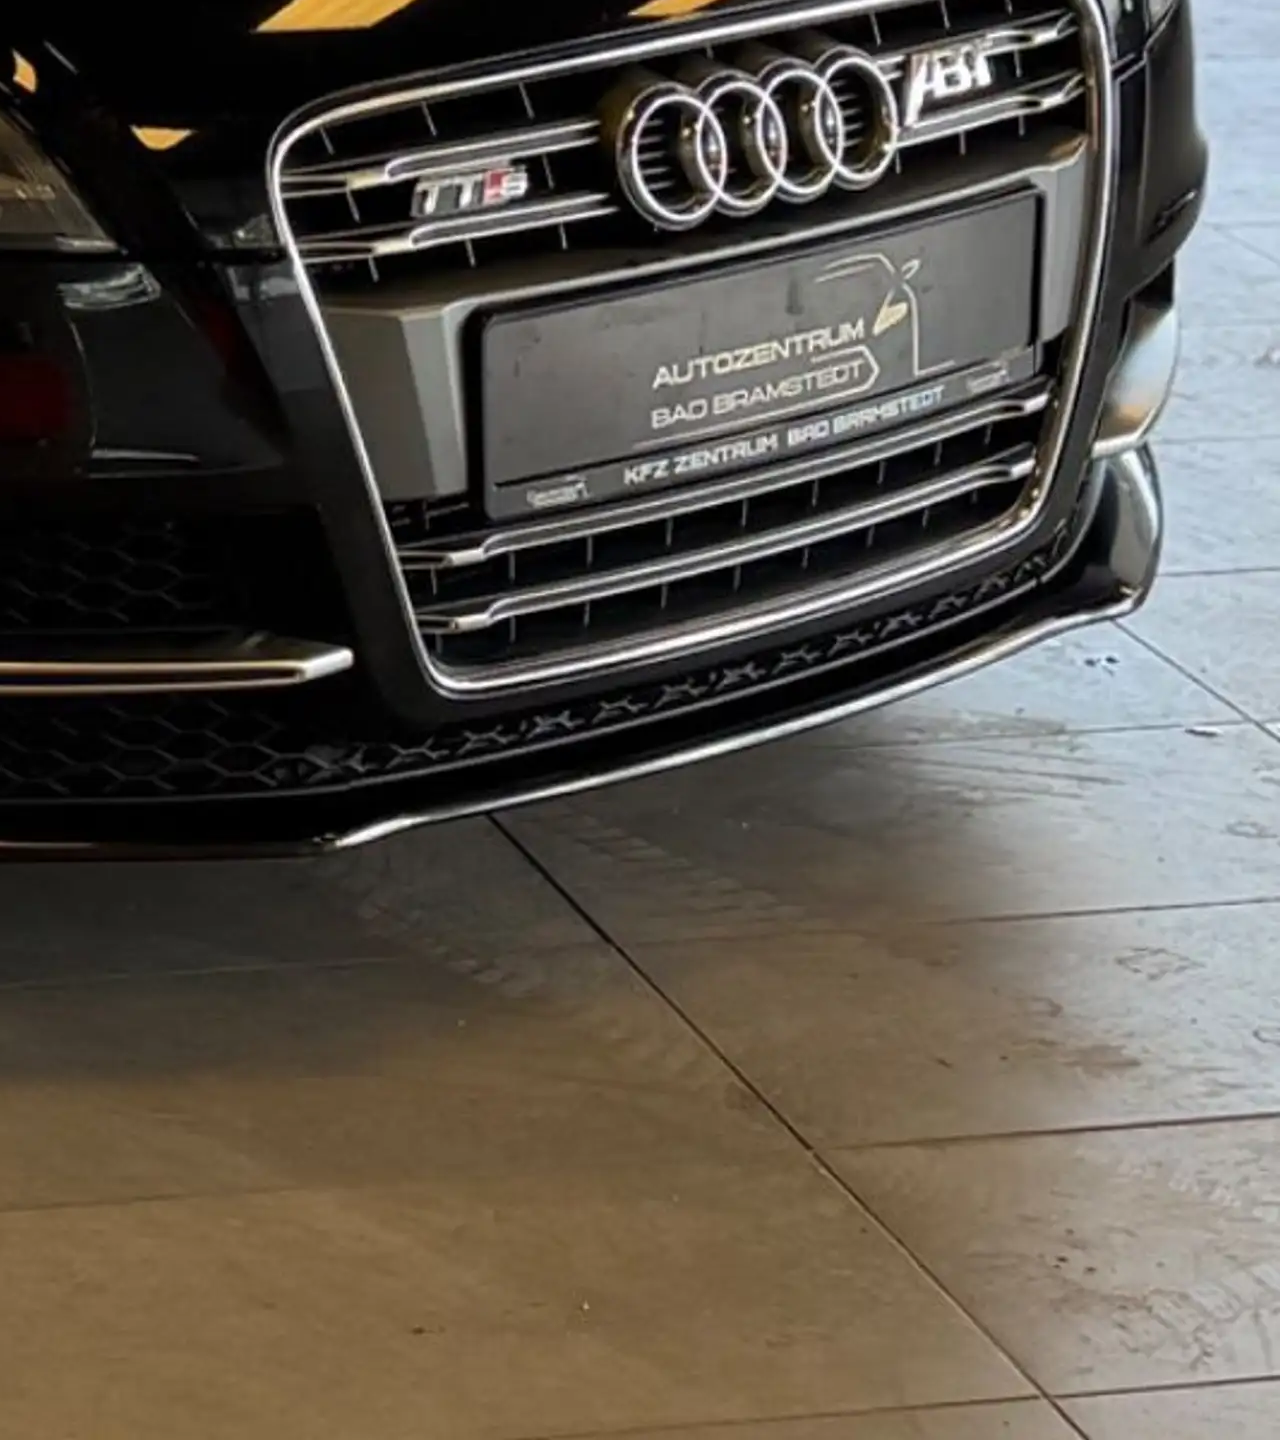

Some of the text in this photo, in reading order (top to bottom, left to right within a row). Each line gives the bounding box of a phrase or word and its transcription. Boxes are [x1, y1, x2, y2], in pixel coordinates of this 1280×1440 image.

[903, 41, 992, 128] ABT
[409, 167, 528, 216] TTS
[652, 317, 865, 389] AUTOZENTRUM
[651, 359, 865, 429] BAD BRAMSTEDT
[623, 458, 670, 486] KFZ
[673, 432, 779, 475] ZENTRUM
[788, 419, 830, 447] BAD
